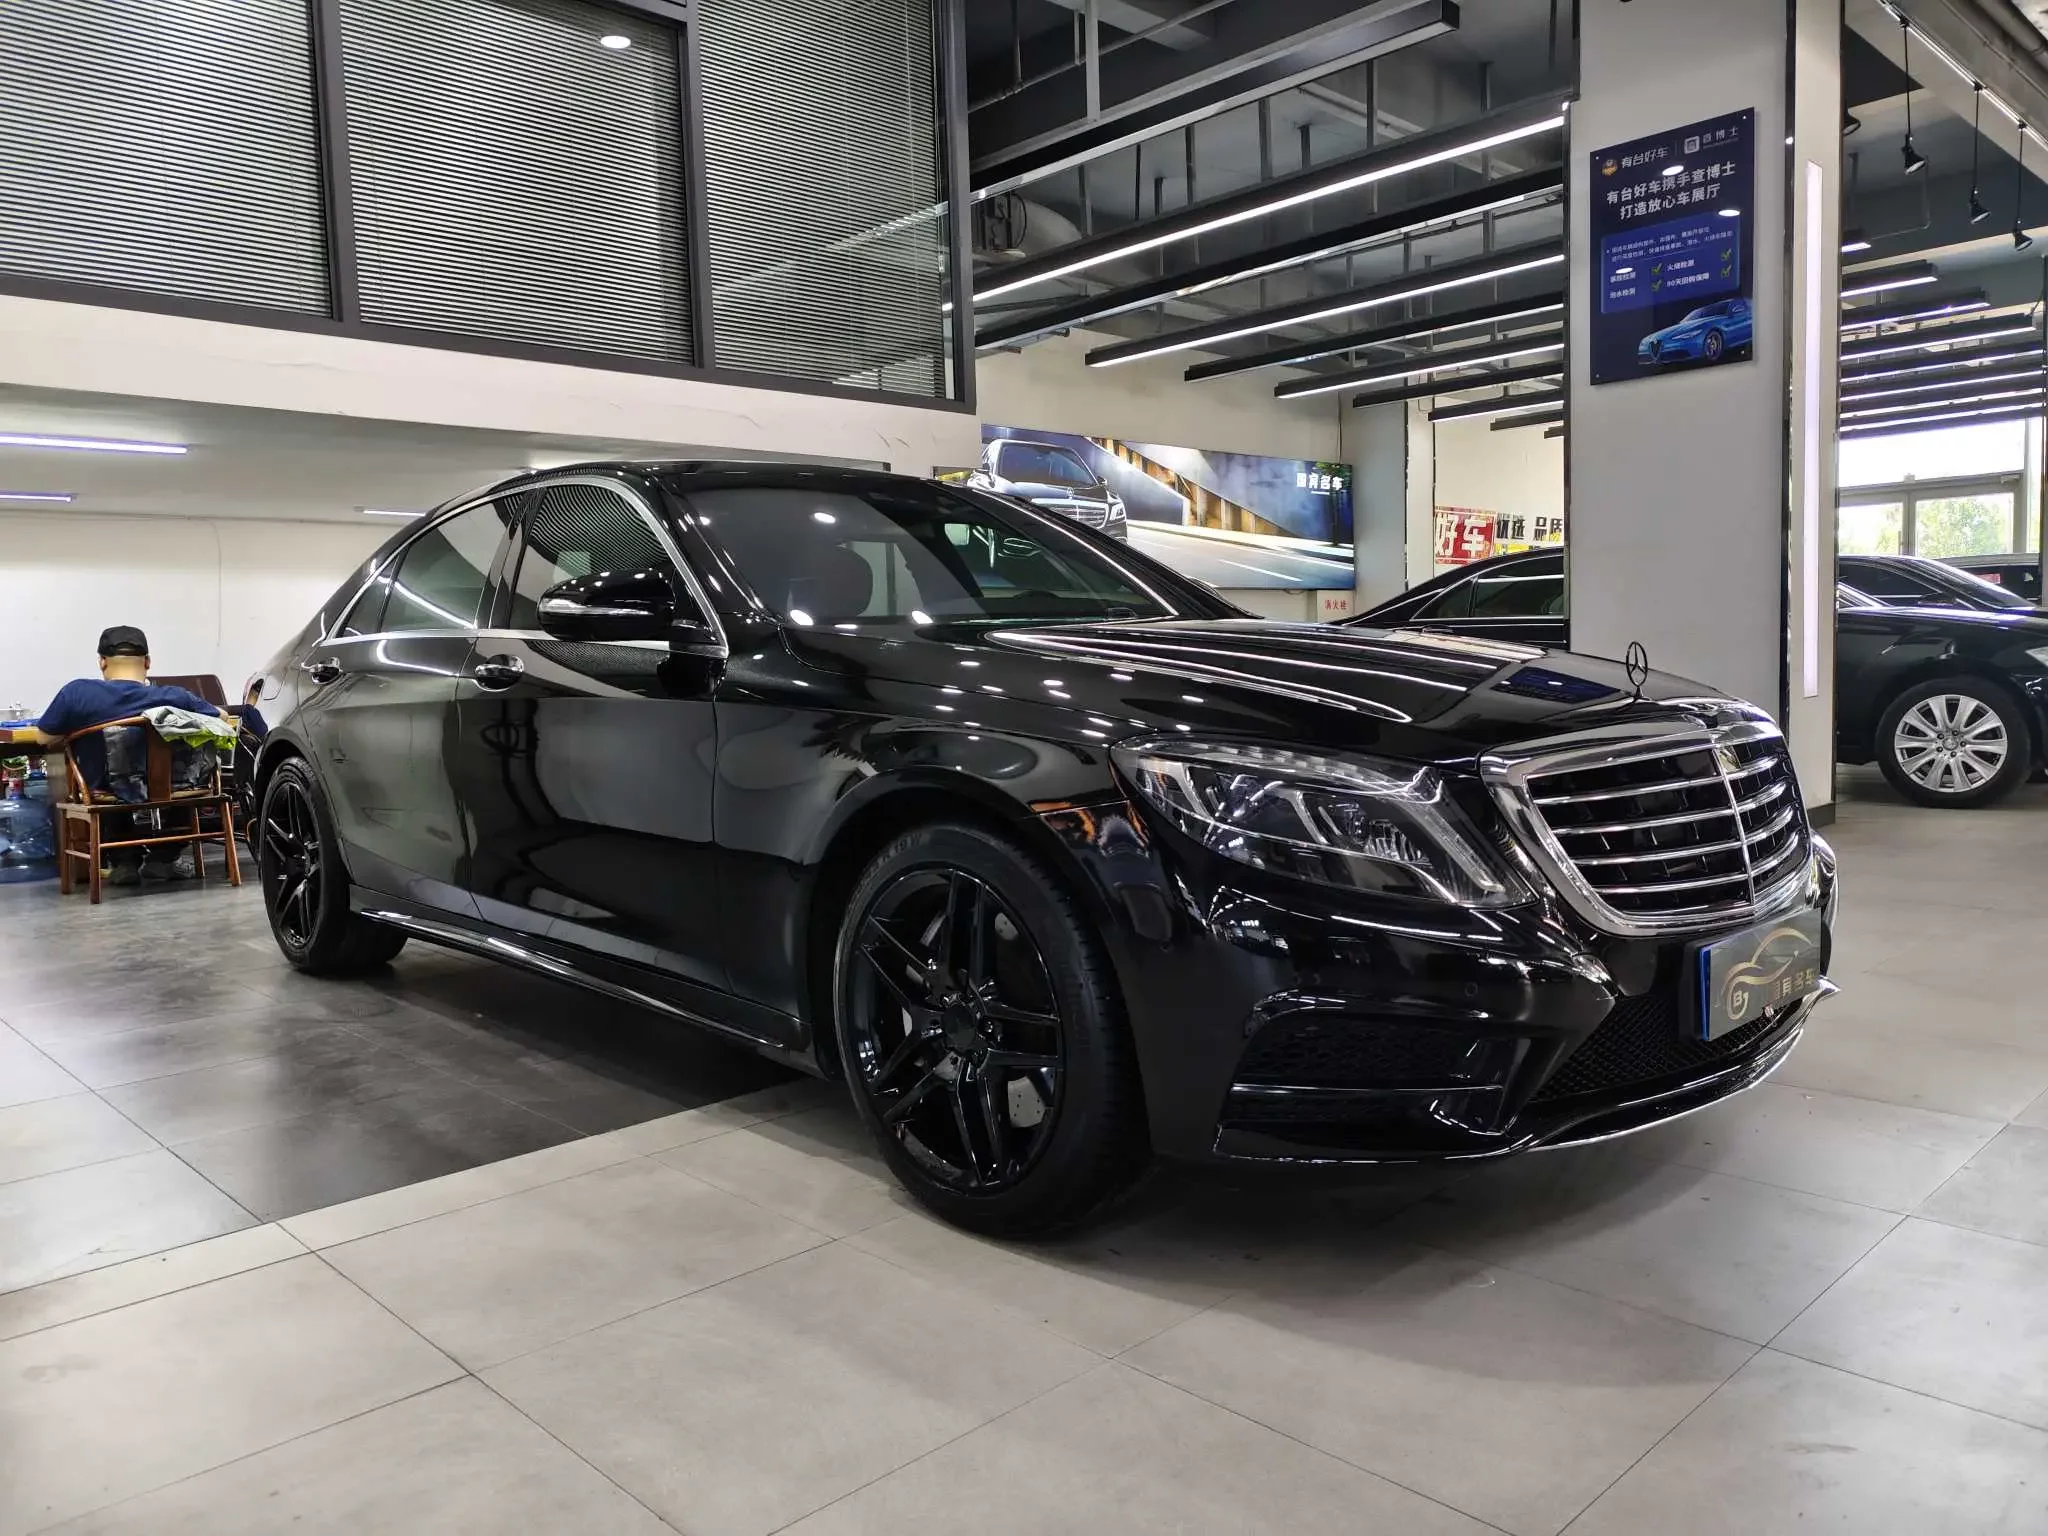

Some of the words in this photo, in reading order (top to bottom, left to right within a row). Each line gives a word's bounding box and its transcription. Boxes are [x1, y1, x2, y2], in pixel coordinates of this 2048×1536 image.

[1621, 146, 1668, 168] 有台好车
[1606, 160, 1736, 204] 有台好车携手查博士
[1620, 183, 1721, 219] 打造放心车展厅
